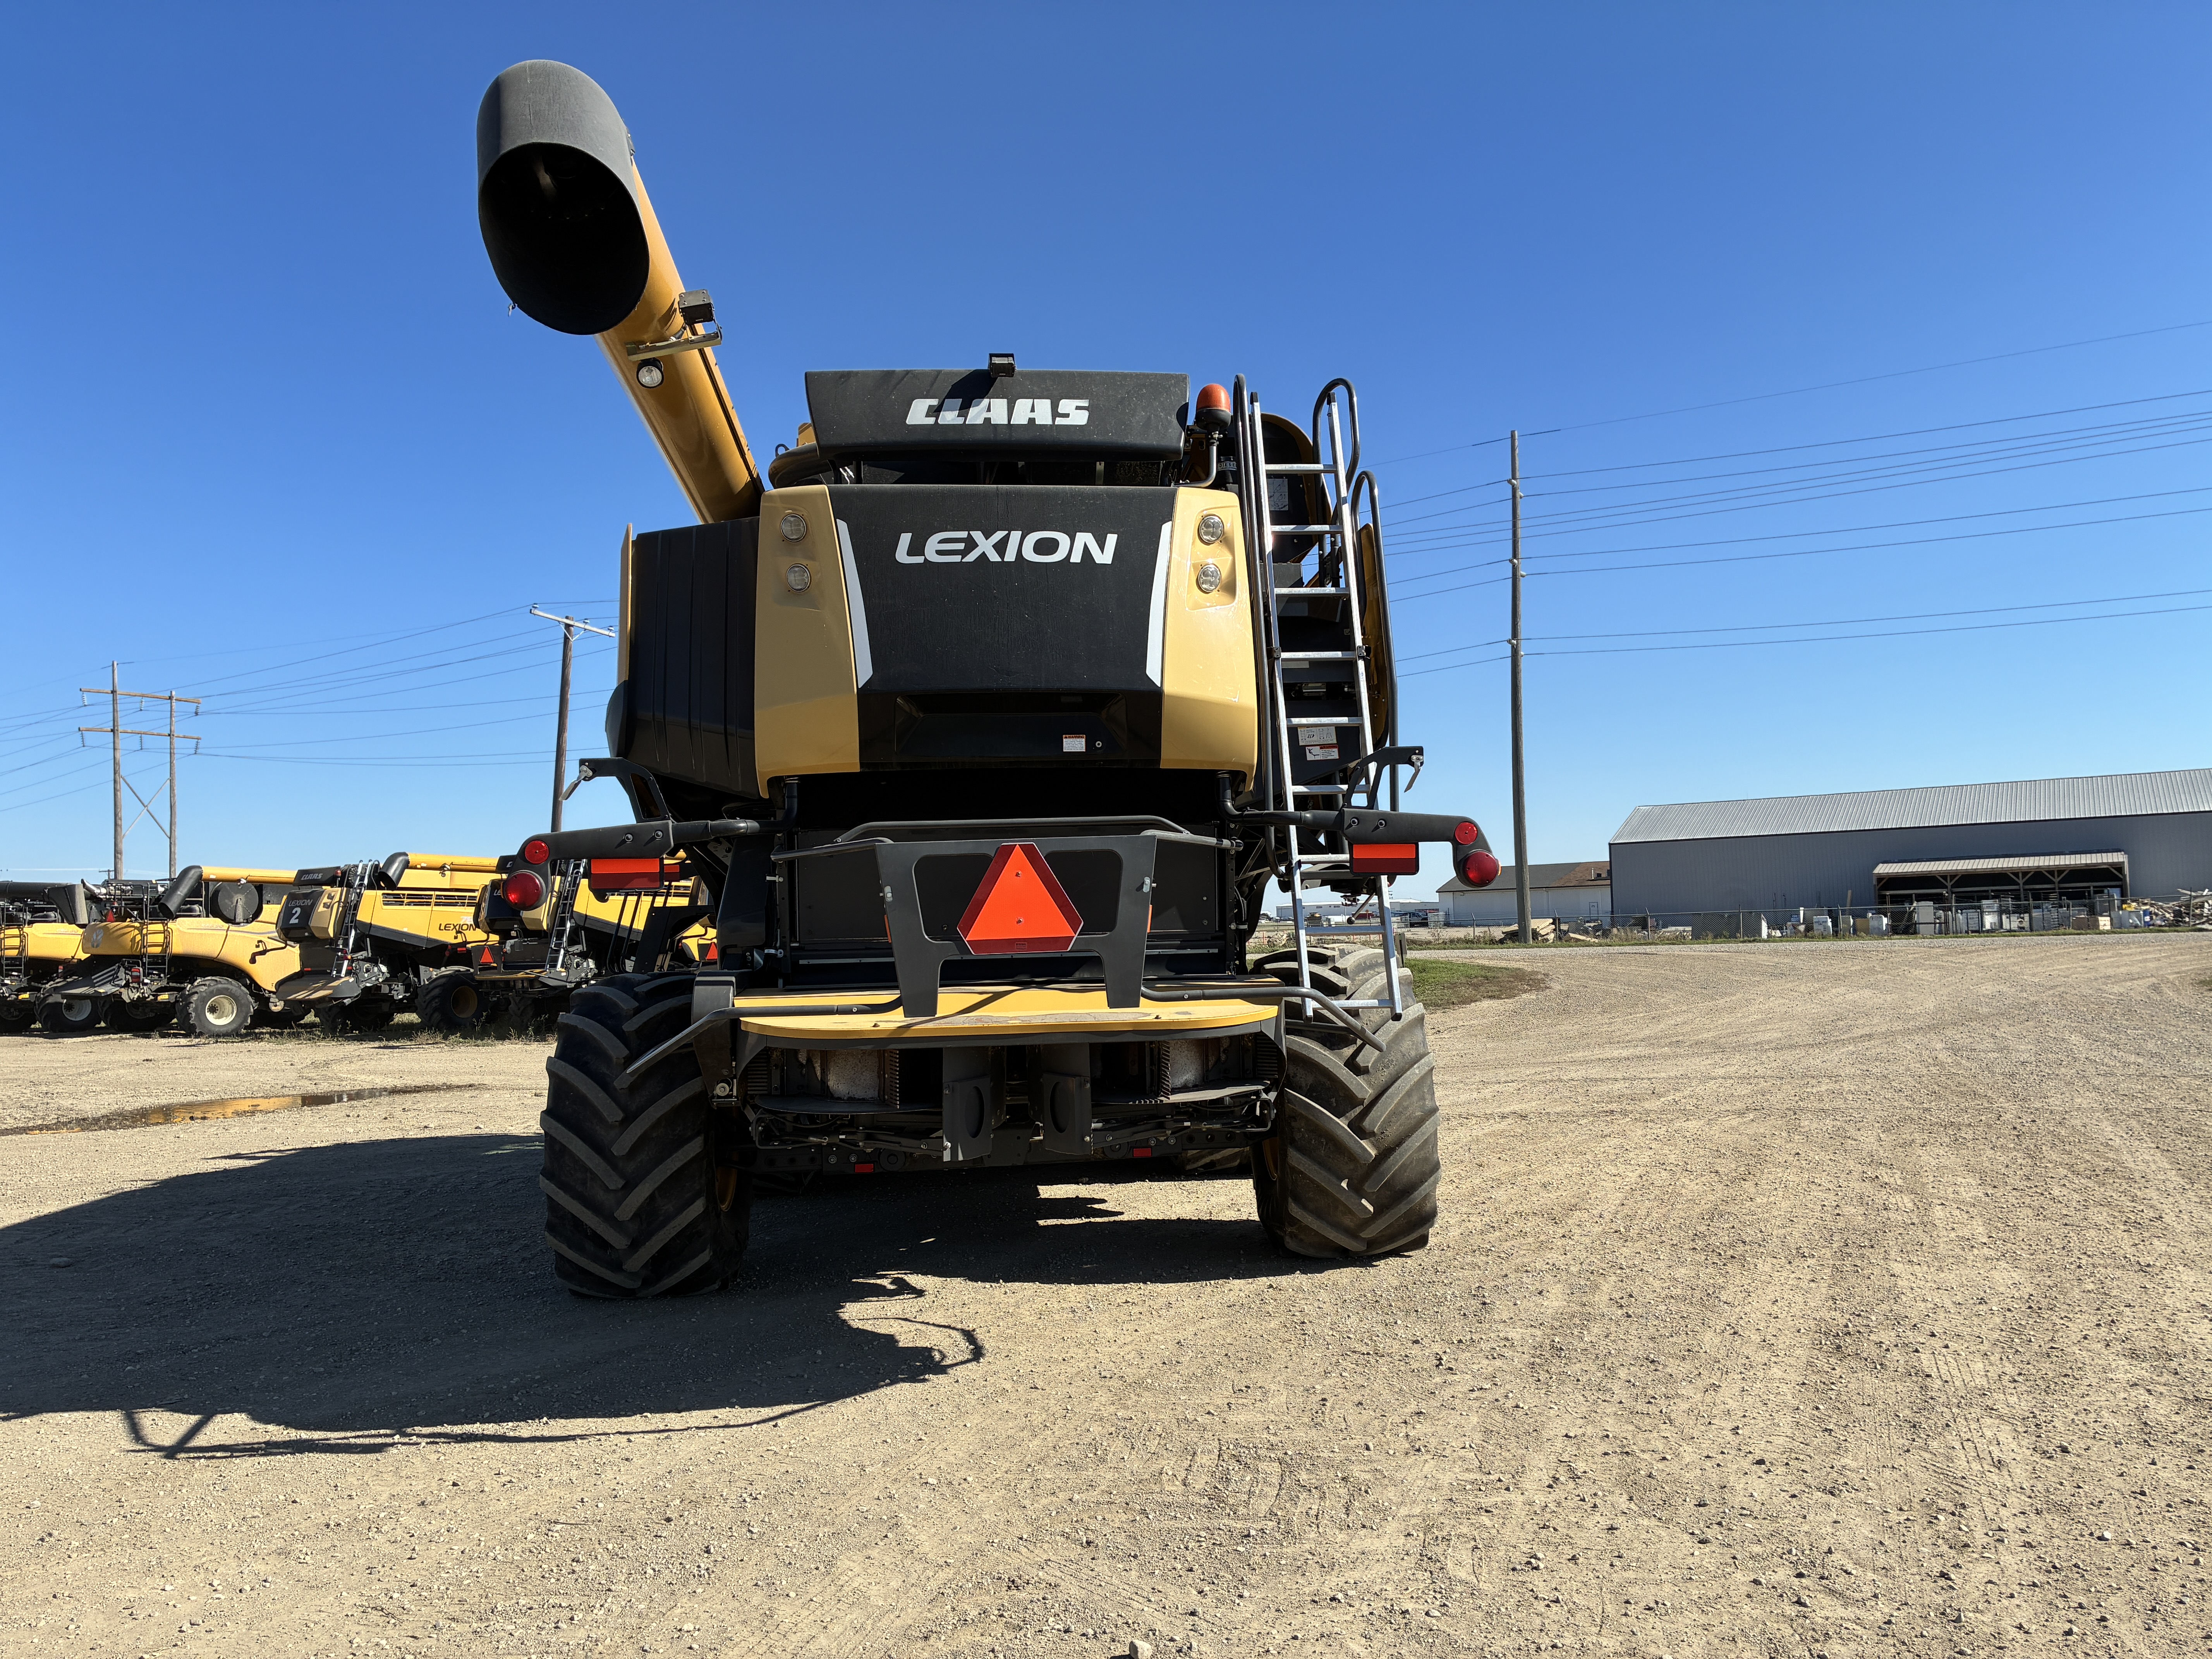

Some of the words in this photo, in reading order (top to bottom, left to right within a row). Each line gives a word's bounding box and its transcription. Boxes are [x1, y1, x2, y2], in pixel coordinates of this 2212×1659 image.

[906, 398, 1089, 425] CLAAS
[895, 531, 1118, 564] LEXION
[289, 907, 301, 924] 2
